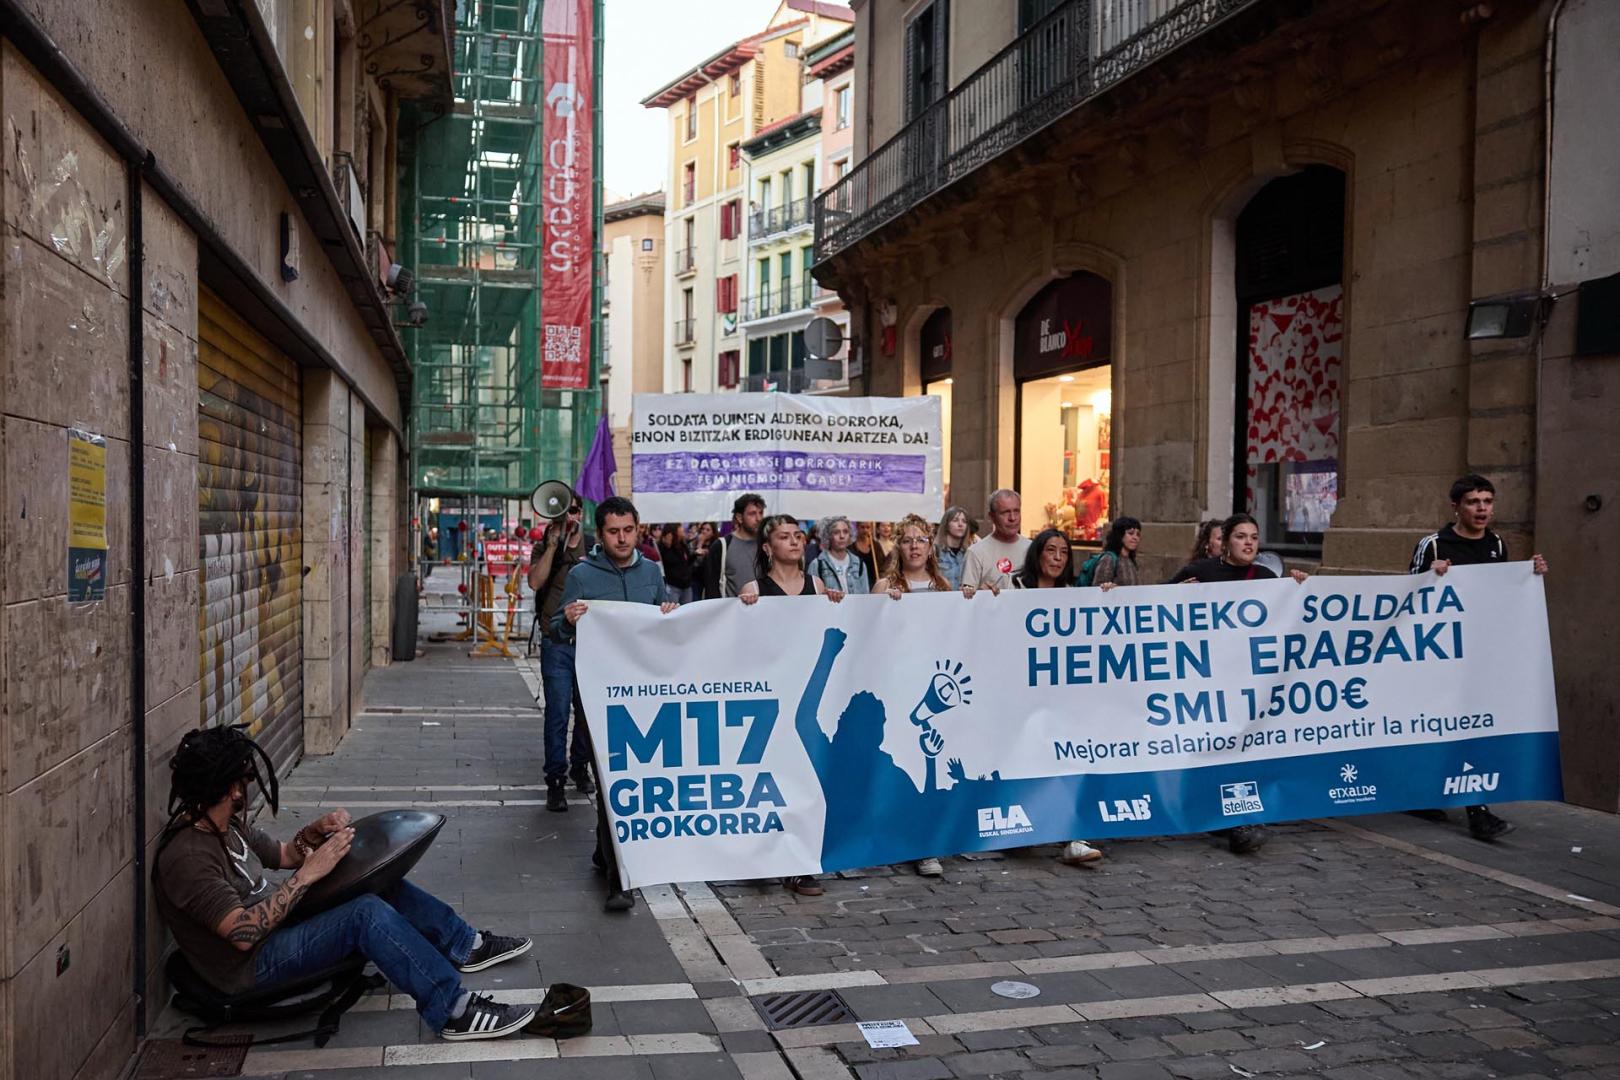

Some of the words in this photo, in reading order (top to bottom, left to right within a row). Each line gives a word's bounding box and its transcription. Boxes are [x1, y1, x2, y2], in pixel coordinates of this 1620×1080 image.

[632, 430, 675, 443] ENON
[680, 429, 742, 442] BIZITZAK
[745, 428, 833, 442] ERDIGUNEAN
[837, 431, 898, 444] JARTZEA
[903, 431, 929, 445] DA!
[648, 413, 708, 427] SOLDATA
[712, 413, 766, 426] DUINEN
[771, 413, 823, 426] ALDEKO
[828, 415, 904, 430] BORROKA,
[665, 458, 684, 470] EZ
[784, 457, 884, 471] BORROKARIK
[1025, 598, 1269, 638] GUTXIENEKO
[1302, 584, 1465, 624] SOLDATA
[1027, 639, 1212, 687] HEMEN
[1249, 621, 1464, 676] ERABAKI
[606, 685, 634, 699] 17M
[638, 683, 699, 698] HUELGA
[702, 681, 773, 695] GENERAL
[1146, 690, 1228, 727] SMI
[1241, 676, 1369, 722] 1.500€
[606, 698, 780, 773] M17
[1053, 739, 1140, 764] Mejorar
[1148, 733, 1237, 757] salarios
[1241, 727, 1287, 752] para
[1294, 716, 1376, 745] repartir
[1383, 716, 1403, 736] la
[1410, 712, 1495, 737] riqueza
[609, 771, 788, 818] GREBA
[1443, 772, 1500, 796] HIRU
[977, 804, 1033, 832] ELA
[1099, 798, 1152, 822] LAB
[615, 811, 785, 844] OROKORRA
